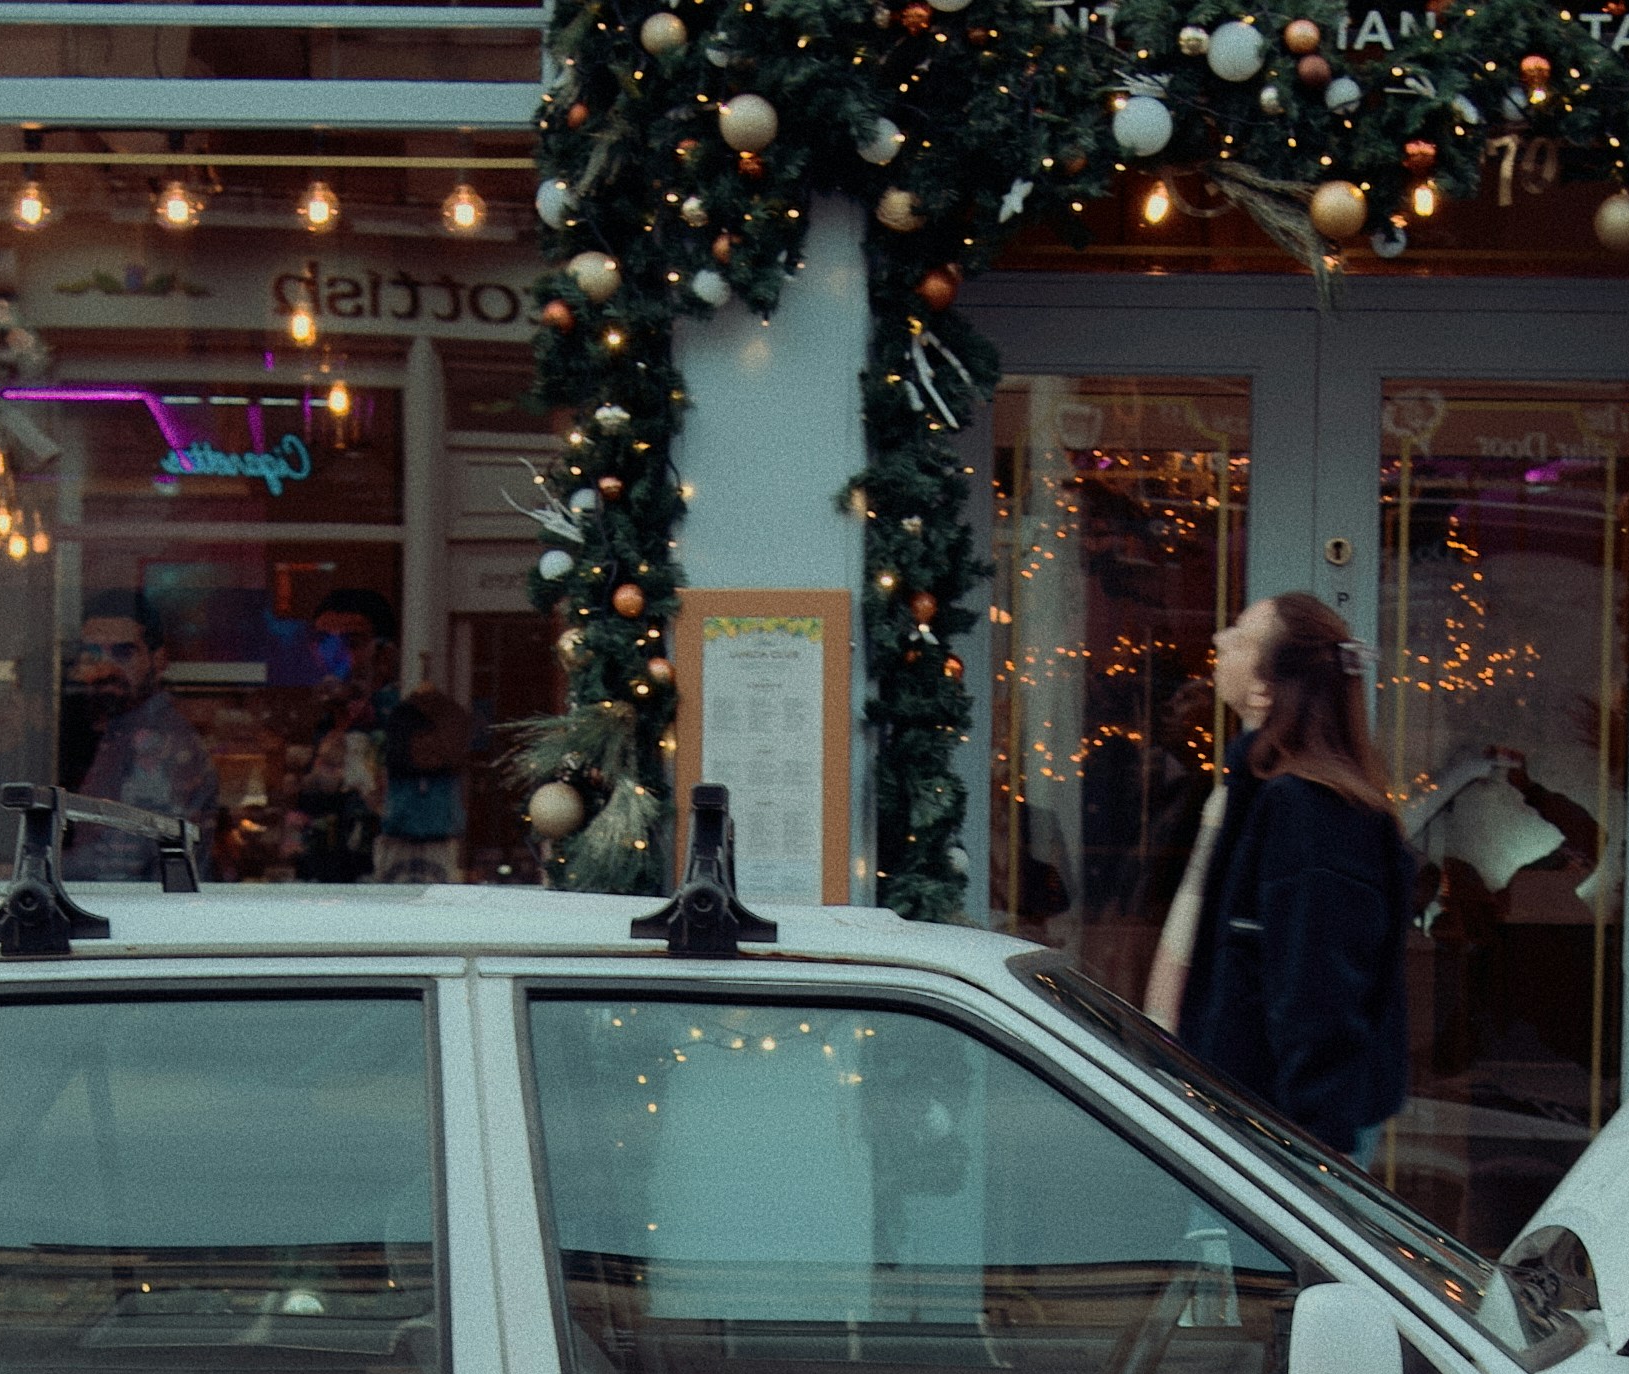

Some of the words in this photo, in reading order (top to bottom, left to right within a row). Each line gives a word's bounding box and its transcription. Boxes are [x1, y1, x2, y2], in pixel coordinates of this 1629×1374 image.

[1337, 10, 1437, 51] IAN
[1485, 133, 1559, 207] 70
[1336, 591, 1351, 609] P
